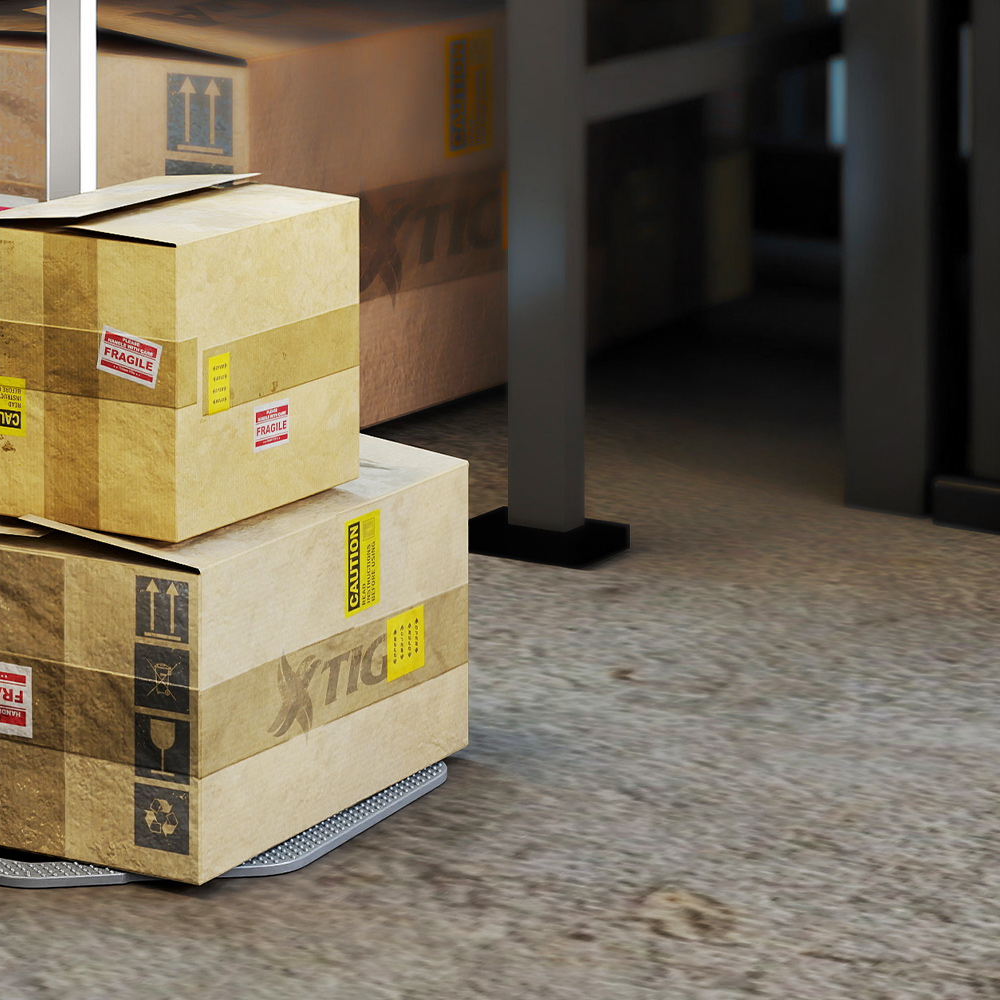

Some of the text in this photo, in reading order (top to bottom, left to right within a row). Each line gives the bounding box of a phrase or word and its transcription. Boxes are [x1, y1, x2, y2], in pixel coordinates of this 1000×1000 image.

[452, 43, 464, 147] CAUTION
[104, 346, 154, 371] FRAGILE
[3, 386, 21, 394] BEFORE
[256, 420, 287, 437] FRAGILE
[349, 524, 359, 608] CAUTION
